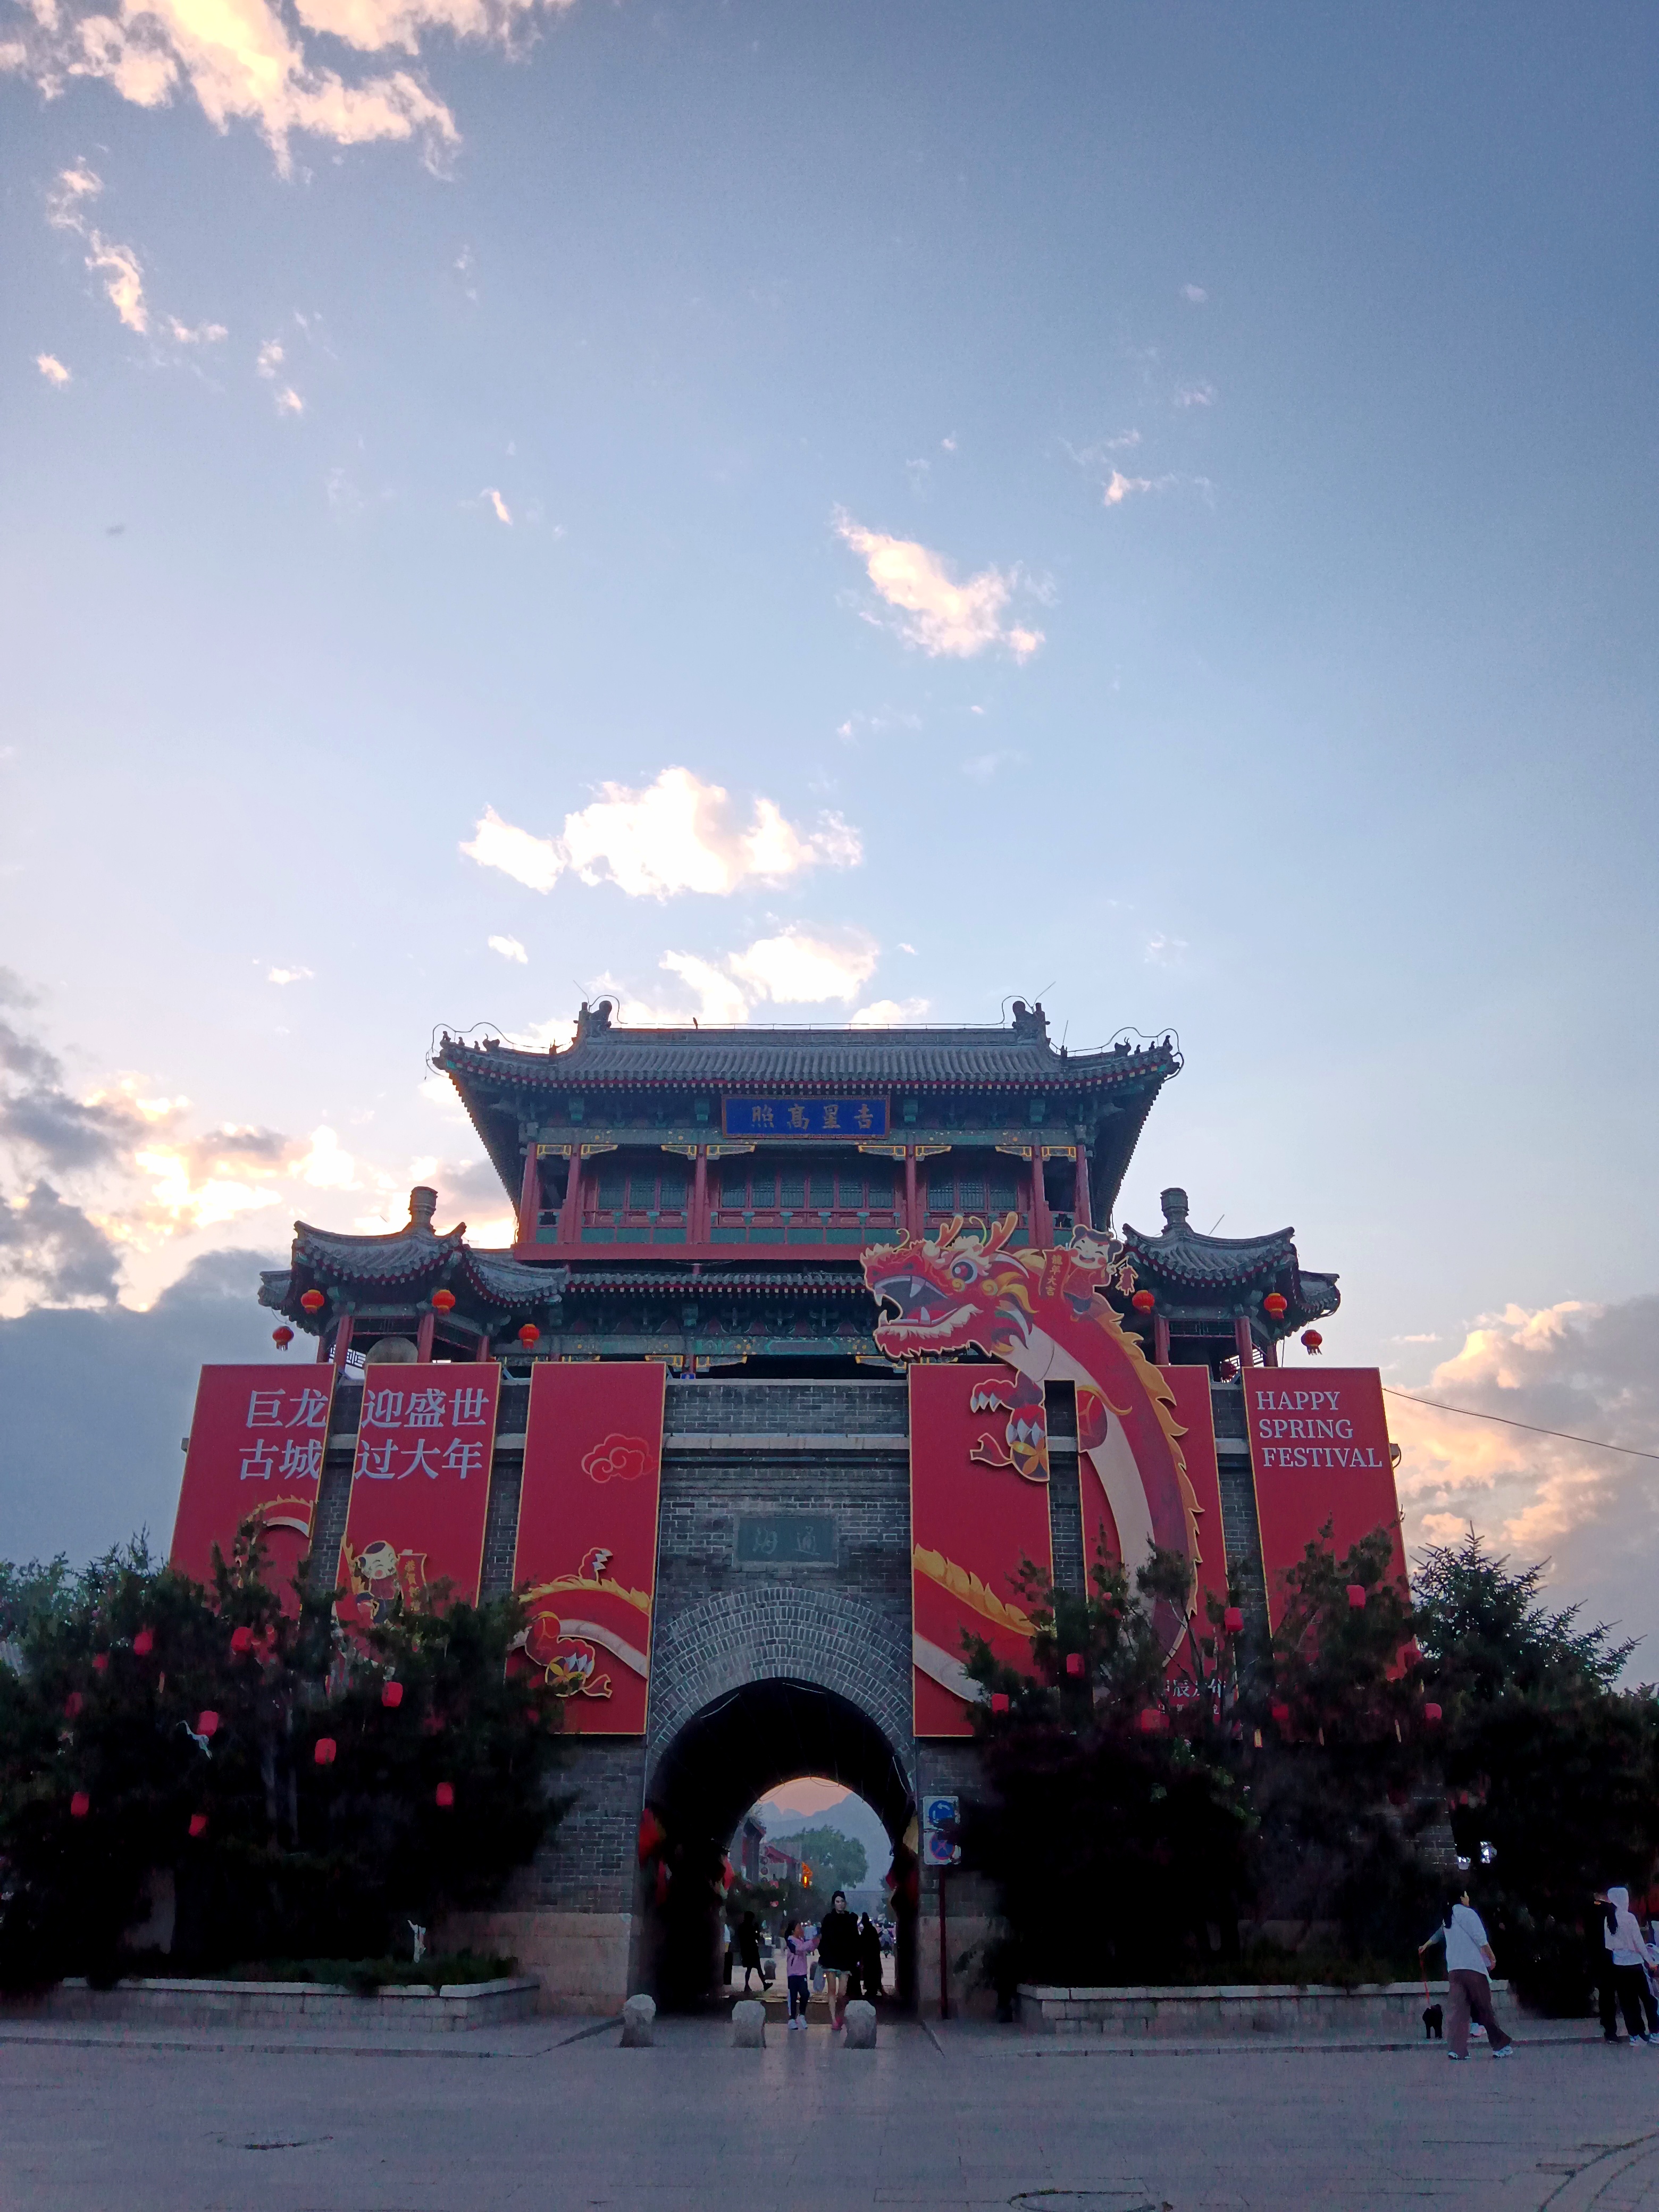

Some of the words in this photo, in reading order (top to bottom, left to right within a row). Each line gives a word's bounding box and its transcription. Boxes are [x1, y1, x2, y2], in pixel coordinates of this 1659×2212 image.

[246, 1388, 329, 1429] 巨龙
[361, 1387, 490, 1429] 迎盛世
[1255, 1391, 1340, 1411] HAPPY
[1259, 1419, 1353, 1439] SPRING
[239, 1438, 322, 1480] 古城
[355, 1437, 483, 1480] 过大年
[1261, 1447, 1383, 1468] FESTIVAL
